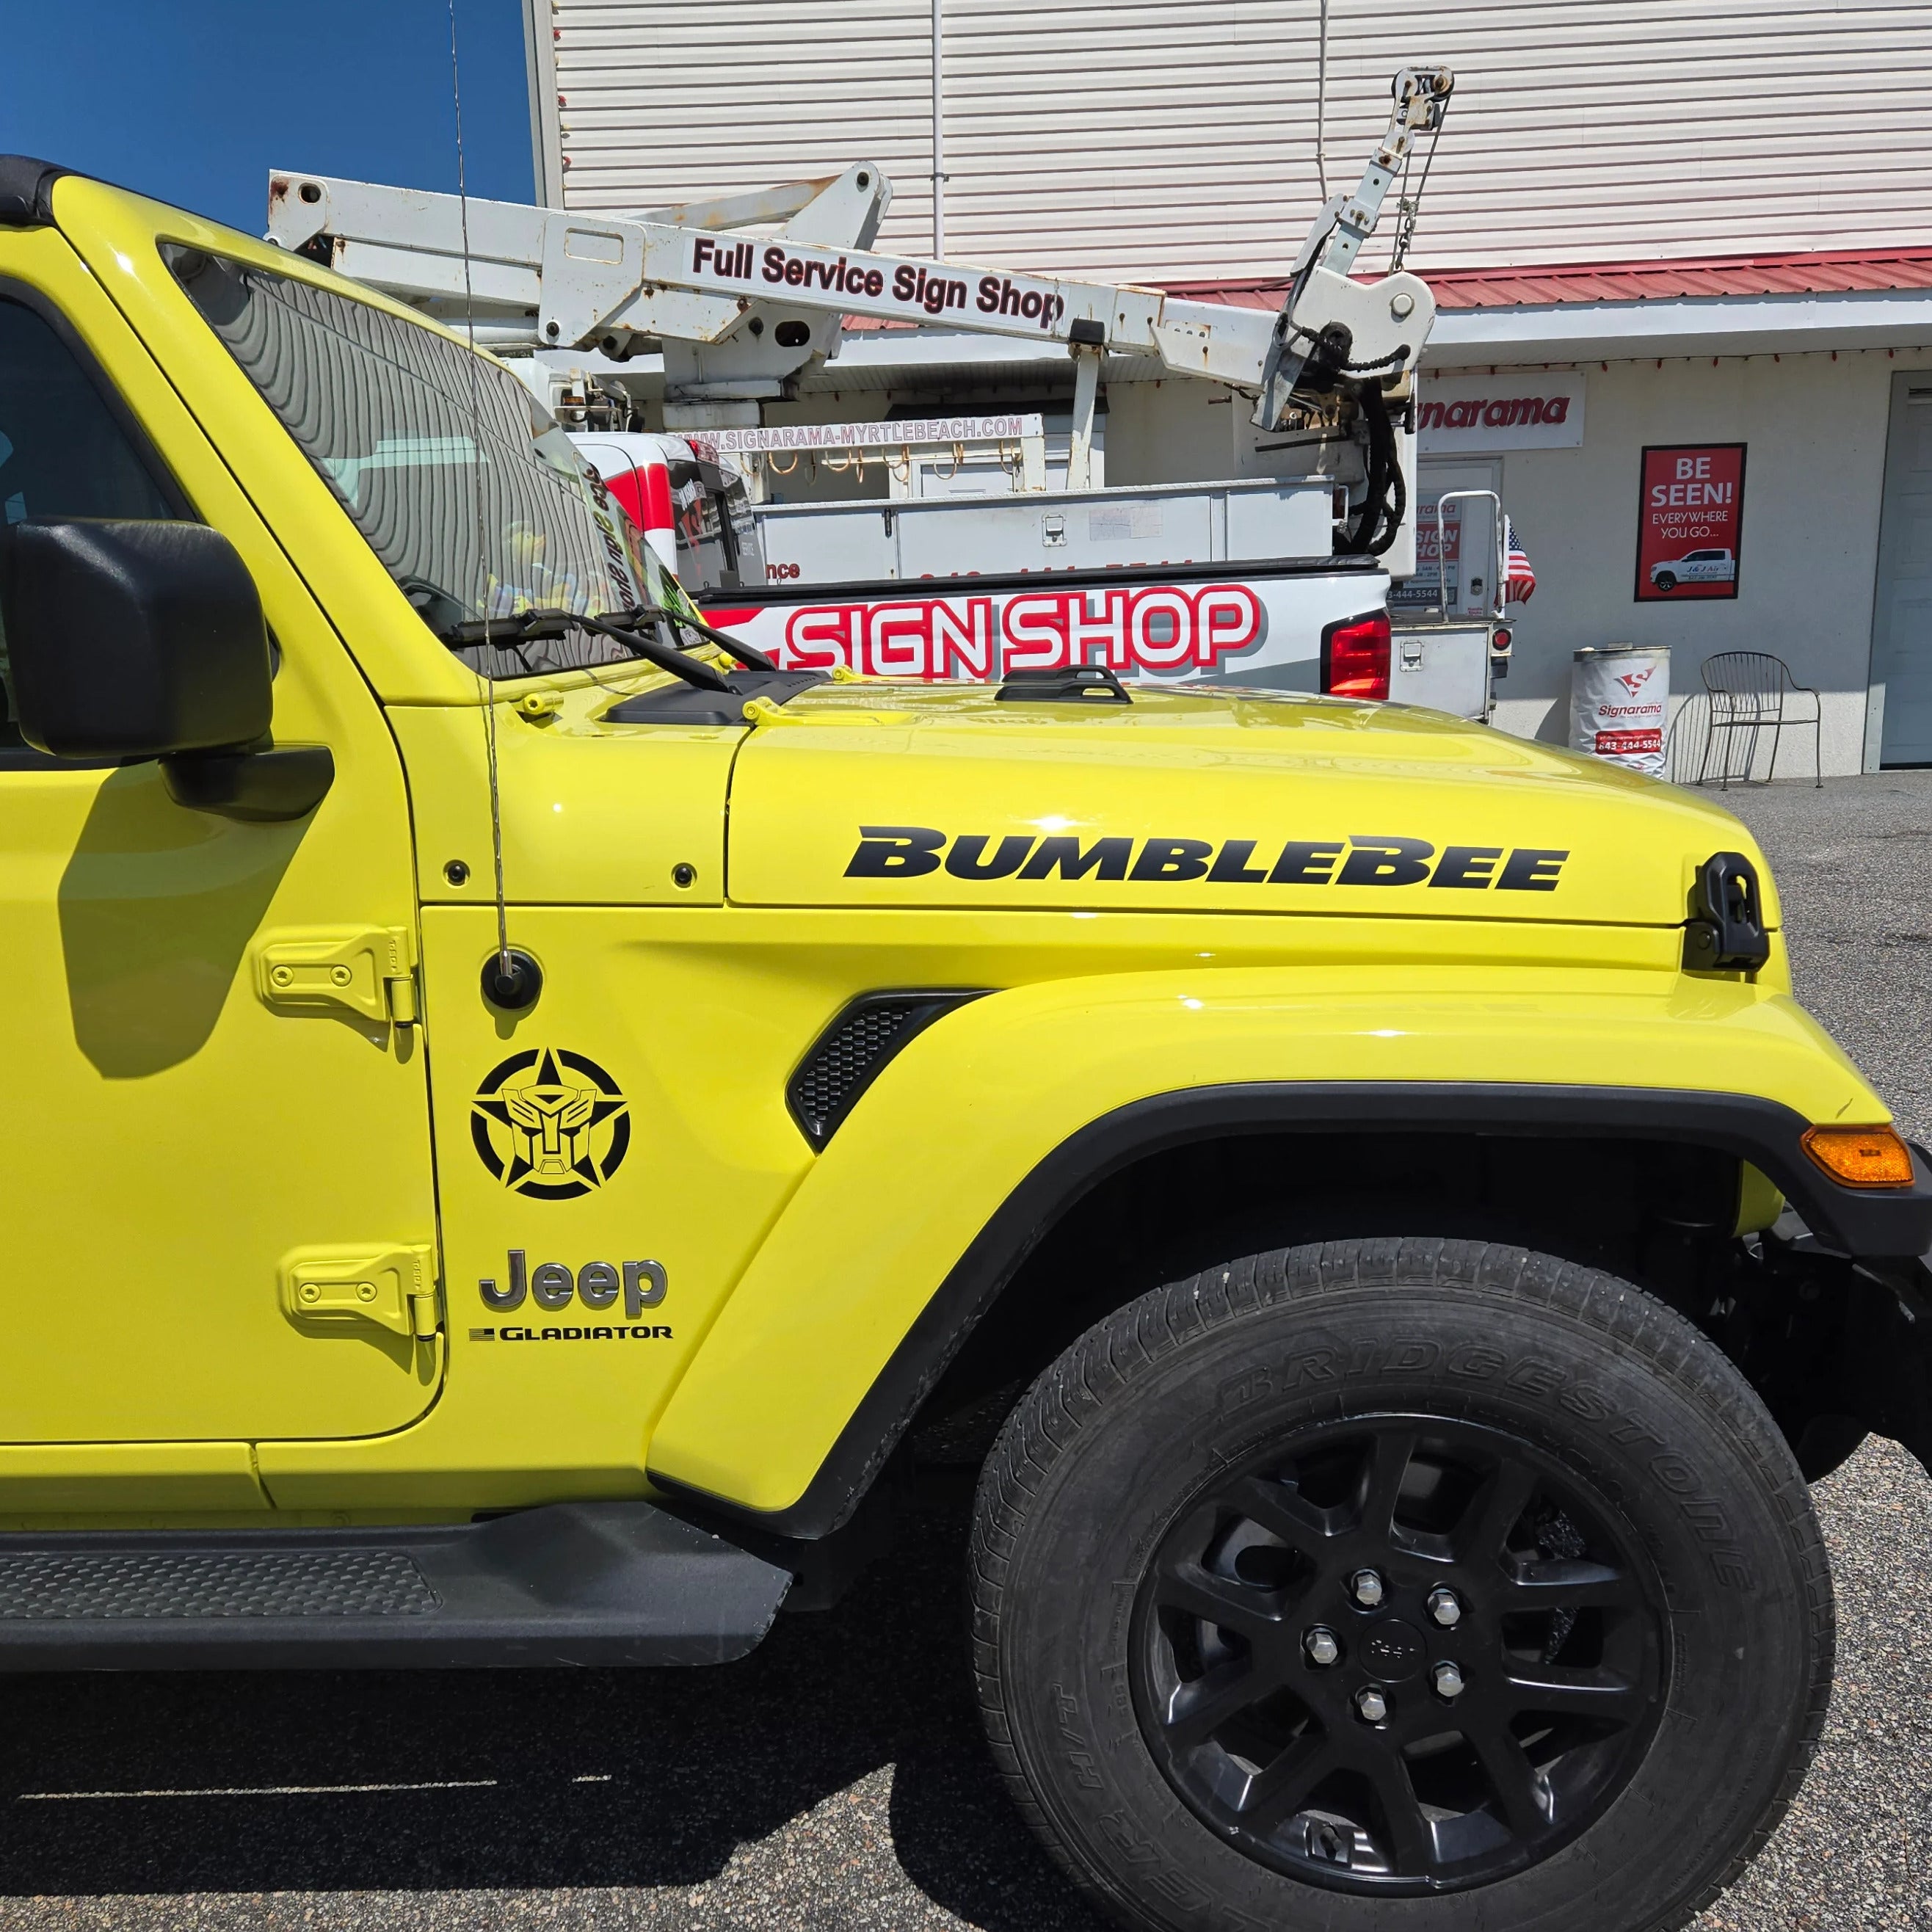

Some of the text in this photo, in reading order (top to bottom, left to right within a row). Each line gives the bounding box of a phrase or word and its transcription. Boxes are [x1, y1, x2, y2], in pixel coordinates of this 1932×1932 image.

[693, 238, 1064, 329] Full Service Sign Shop
[1417, 397, 1571, 430] narama
[676, 417, 1023, 449] W.SIGNARAMA-MYRTLEBEACH.COM
[1676, 457, 1711, 479] BE
[1651, 482, 1732, 506] SEEN!
[1417, 504, 1456, 514] rama
[1652, 511, 1728, 524] EVERYWHERE
[1417, 529, 1458, 544] SIGN
[1661, 526, 1719, 539] YOU GO...
[1417, 544, 1452, 558] HOP
[1387, 589, 1438, 599] 3-444-5544
[784, 584, 1261, 679] SIGN SHOP
[1599, 705, 1662, 717] Signarama
[843, 826, 1570, 891] BUMBLEBEE
[479, 1249, 668, 1321] Jeep
[500, 1326, 673, 1340] GLADIATOR
[1218, 1334, 1759, 1593] BRIDGESTONE
